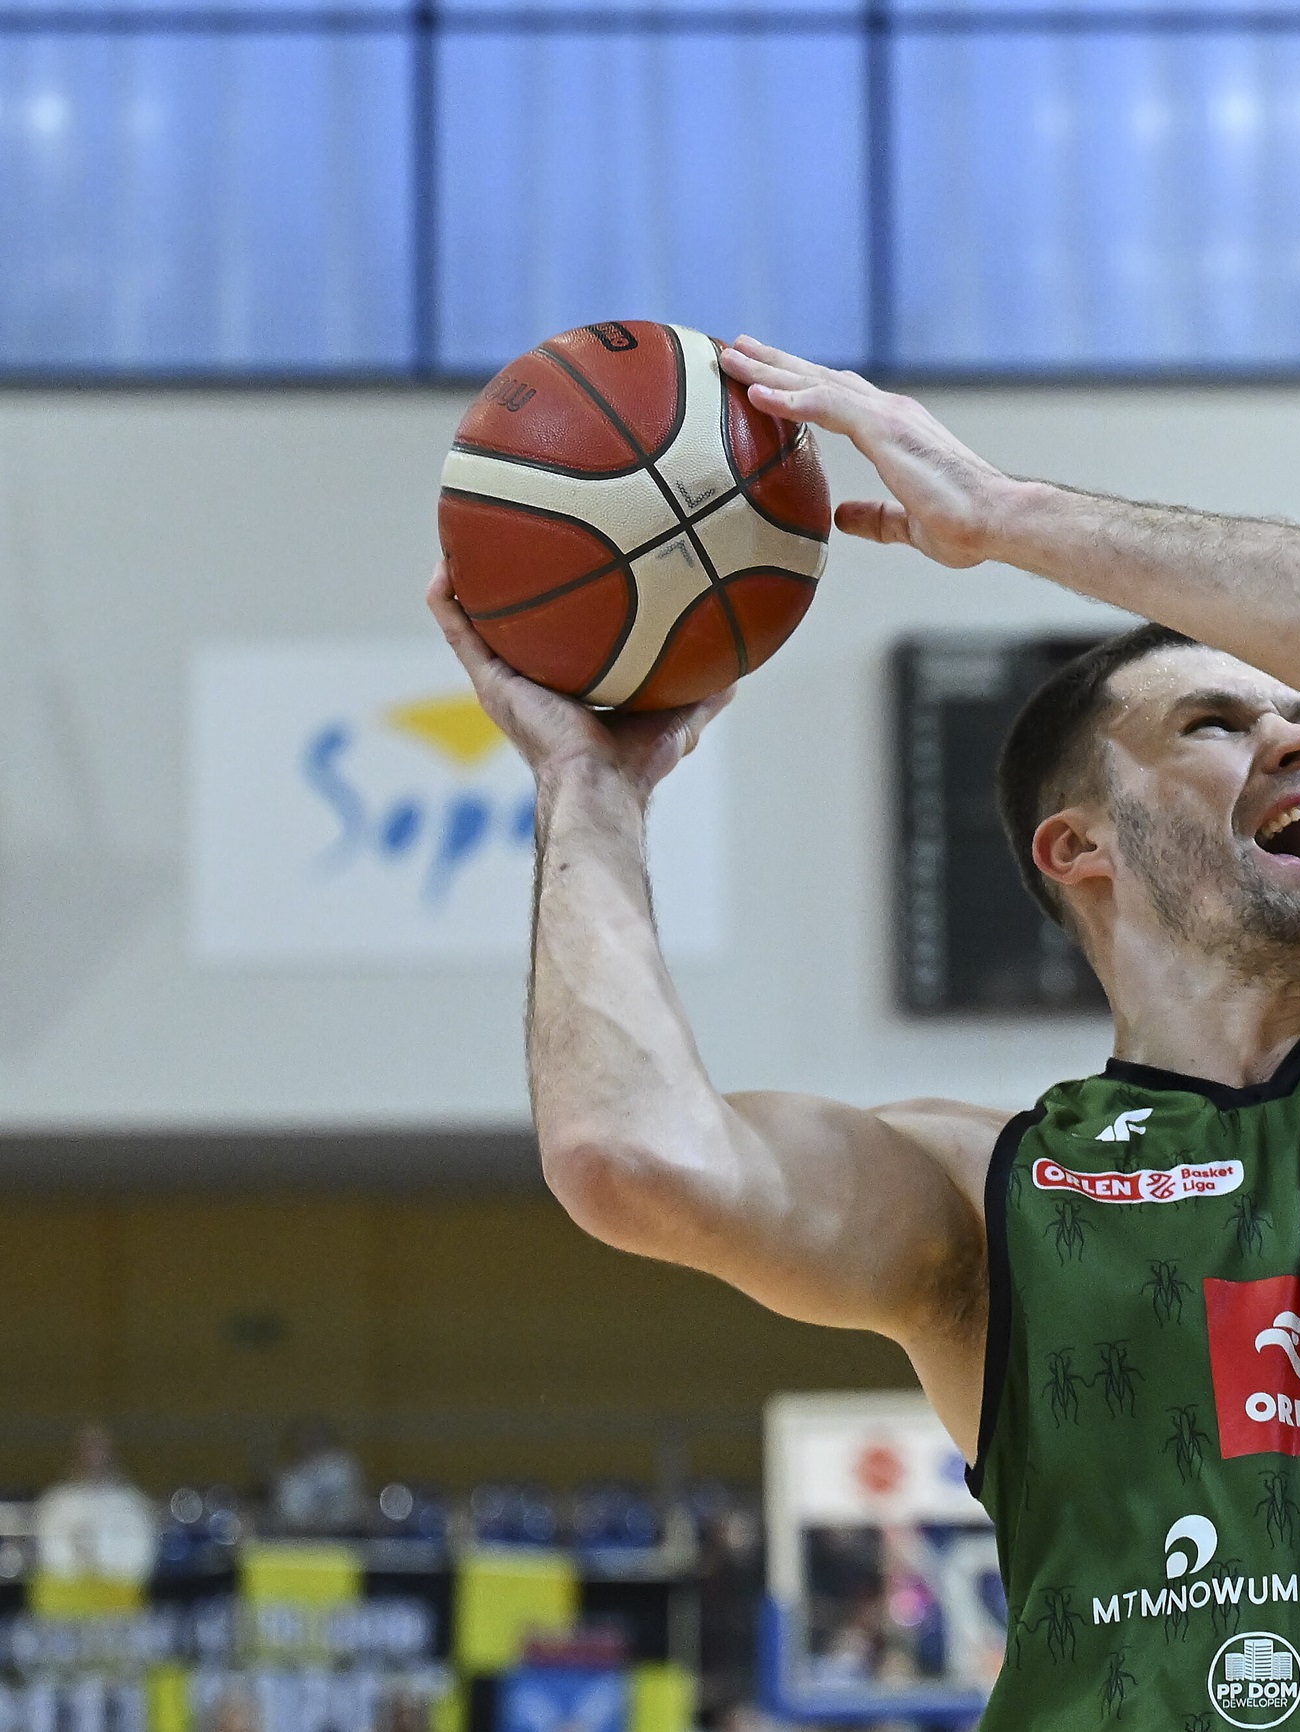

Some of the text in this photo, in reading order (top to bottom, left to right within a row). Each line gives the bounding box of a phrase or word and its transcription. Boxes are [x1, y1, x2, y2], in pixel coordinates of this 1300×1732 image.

[302, 717, 537, 914] Sopo
[1044, 1165, 1132, 1197] ORLEN
[1181, 1166, 1234, 1180] Basket
[1183, 1180, 1216, 1192] Liga
[1216, 1681, 1298, 1700] PP DOM
[1222, 1698, 1288, 1709] DEWELOPER
